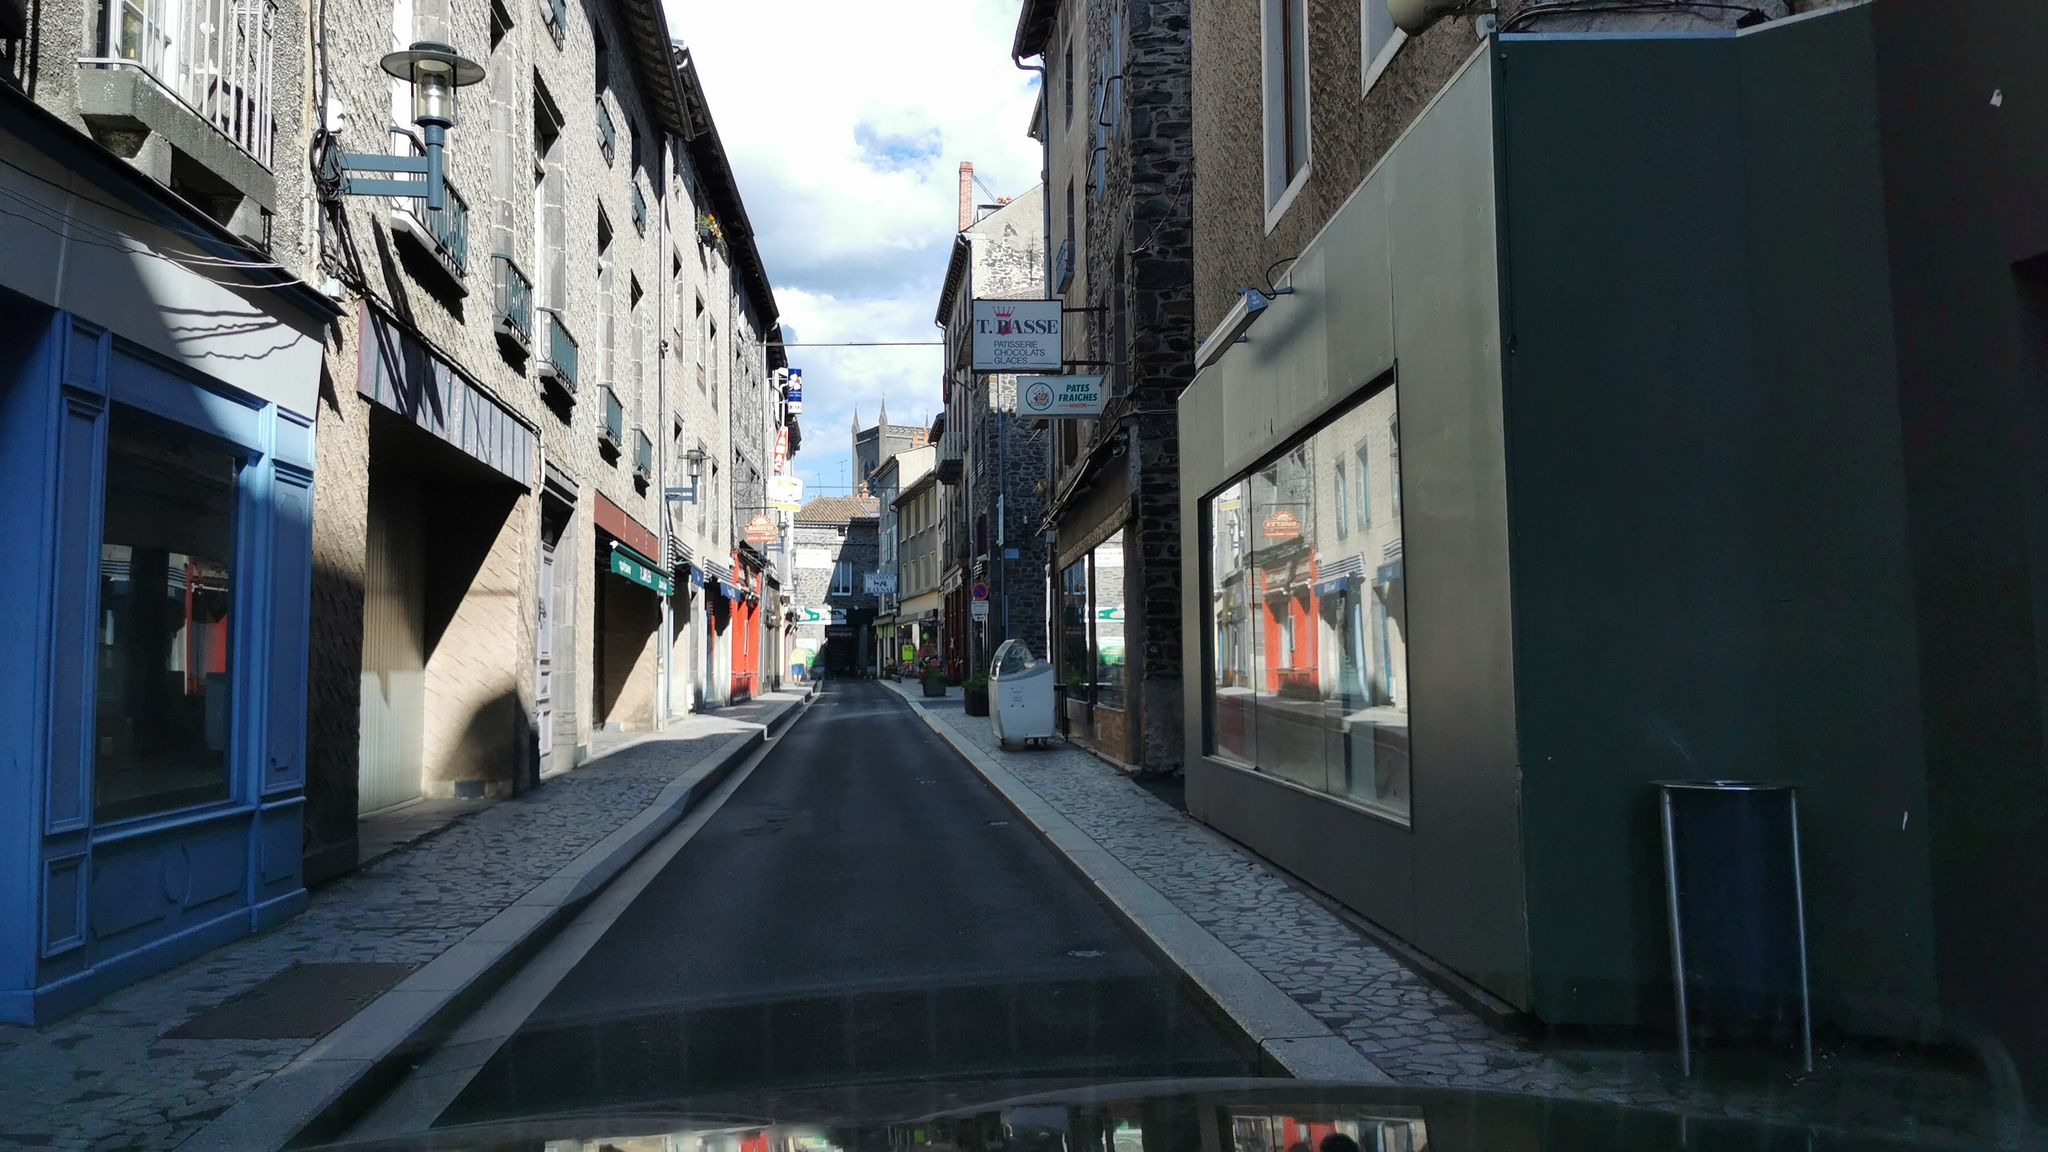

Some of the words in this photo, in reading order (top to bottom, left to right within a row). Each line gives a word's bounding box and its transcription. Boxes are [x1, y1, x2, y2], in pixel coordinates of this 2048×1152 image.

[994, 349, 1046, 357] CHOCOLATS
[994, 357, 1028, 365] GLACES
[1066, 384, 1089, 392] PATES
[1058, 393, 1098, 402] FRAICHES
